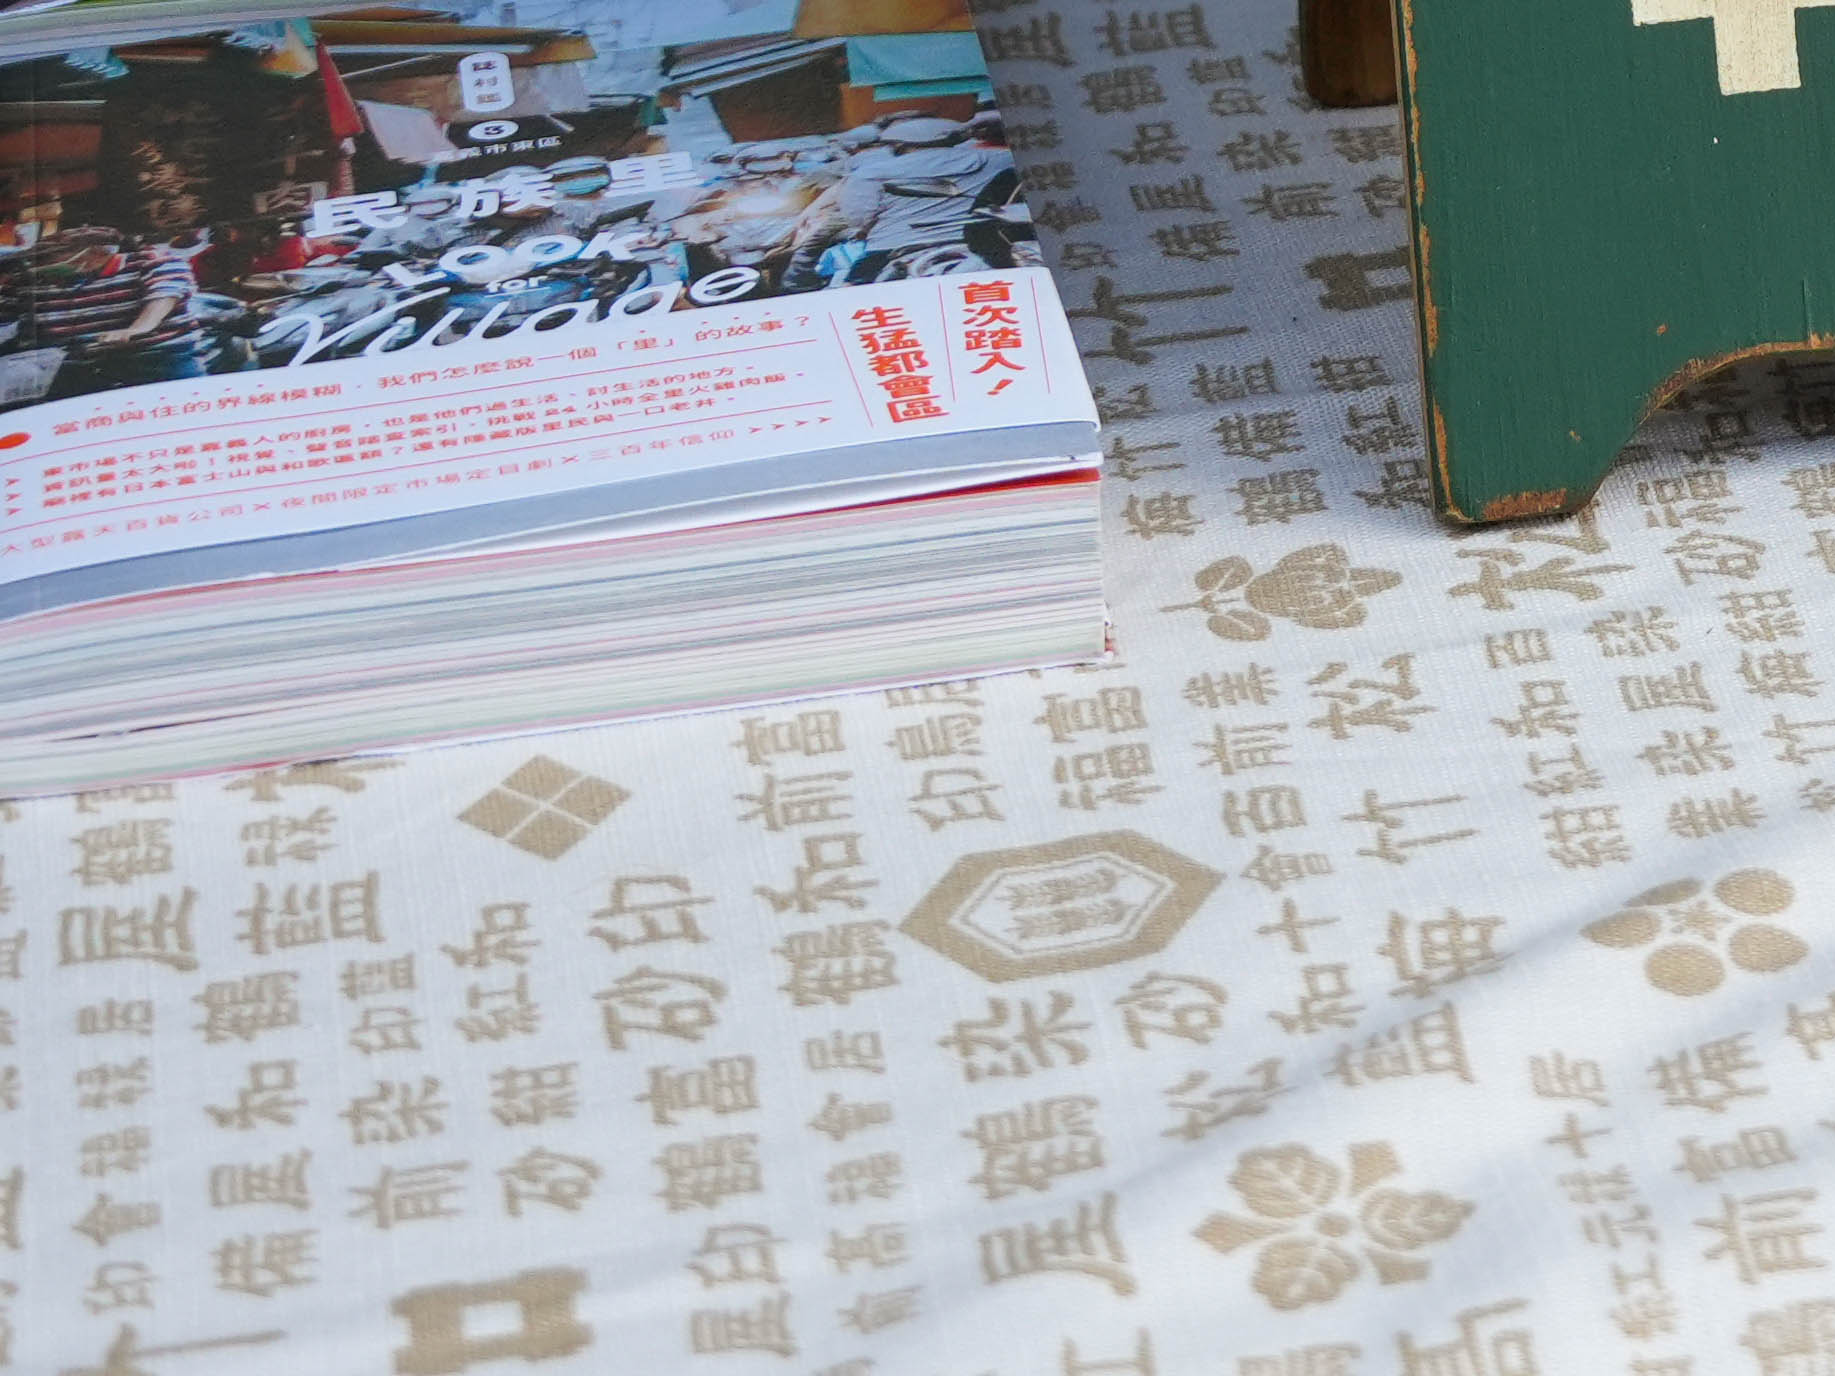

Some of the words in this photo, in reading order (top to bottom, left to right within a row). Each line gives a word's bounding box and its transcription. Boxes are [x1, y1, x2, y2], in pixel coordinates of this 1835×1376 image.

[308, 150, 707, 236] 民族里
[390, 232, 652, 291] LOOK
[487, 272, 549, 298] for
[258, 265, 762, 368] Village
[852, 306, 948, 425] 生猛都會區
